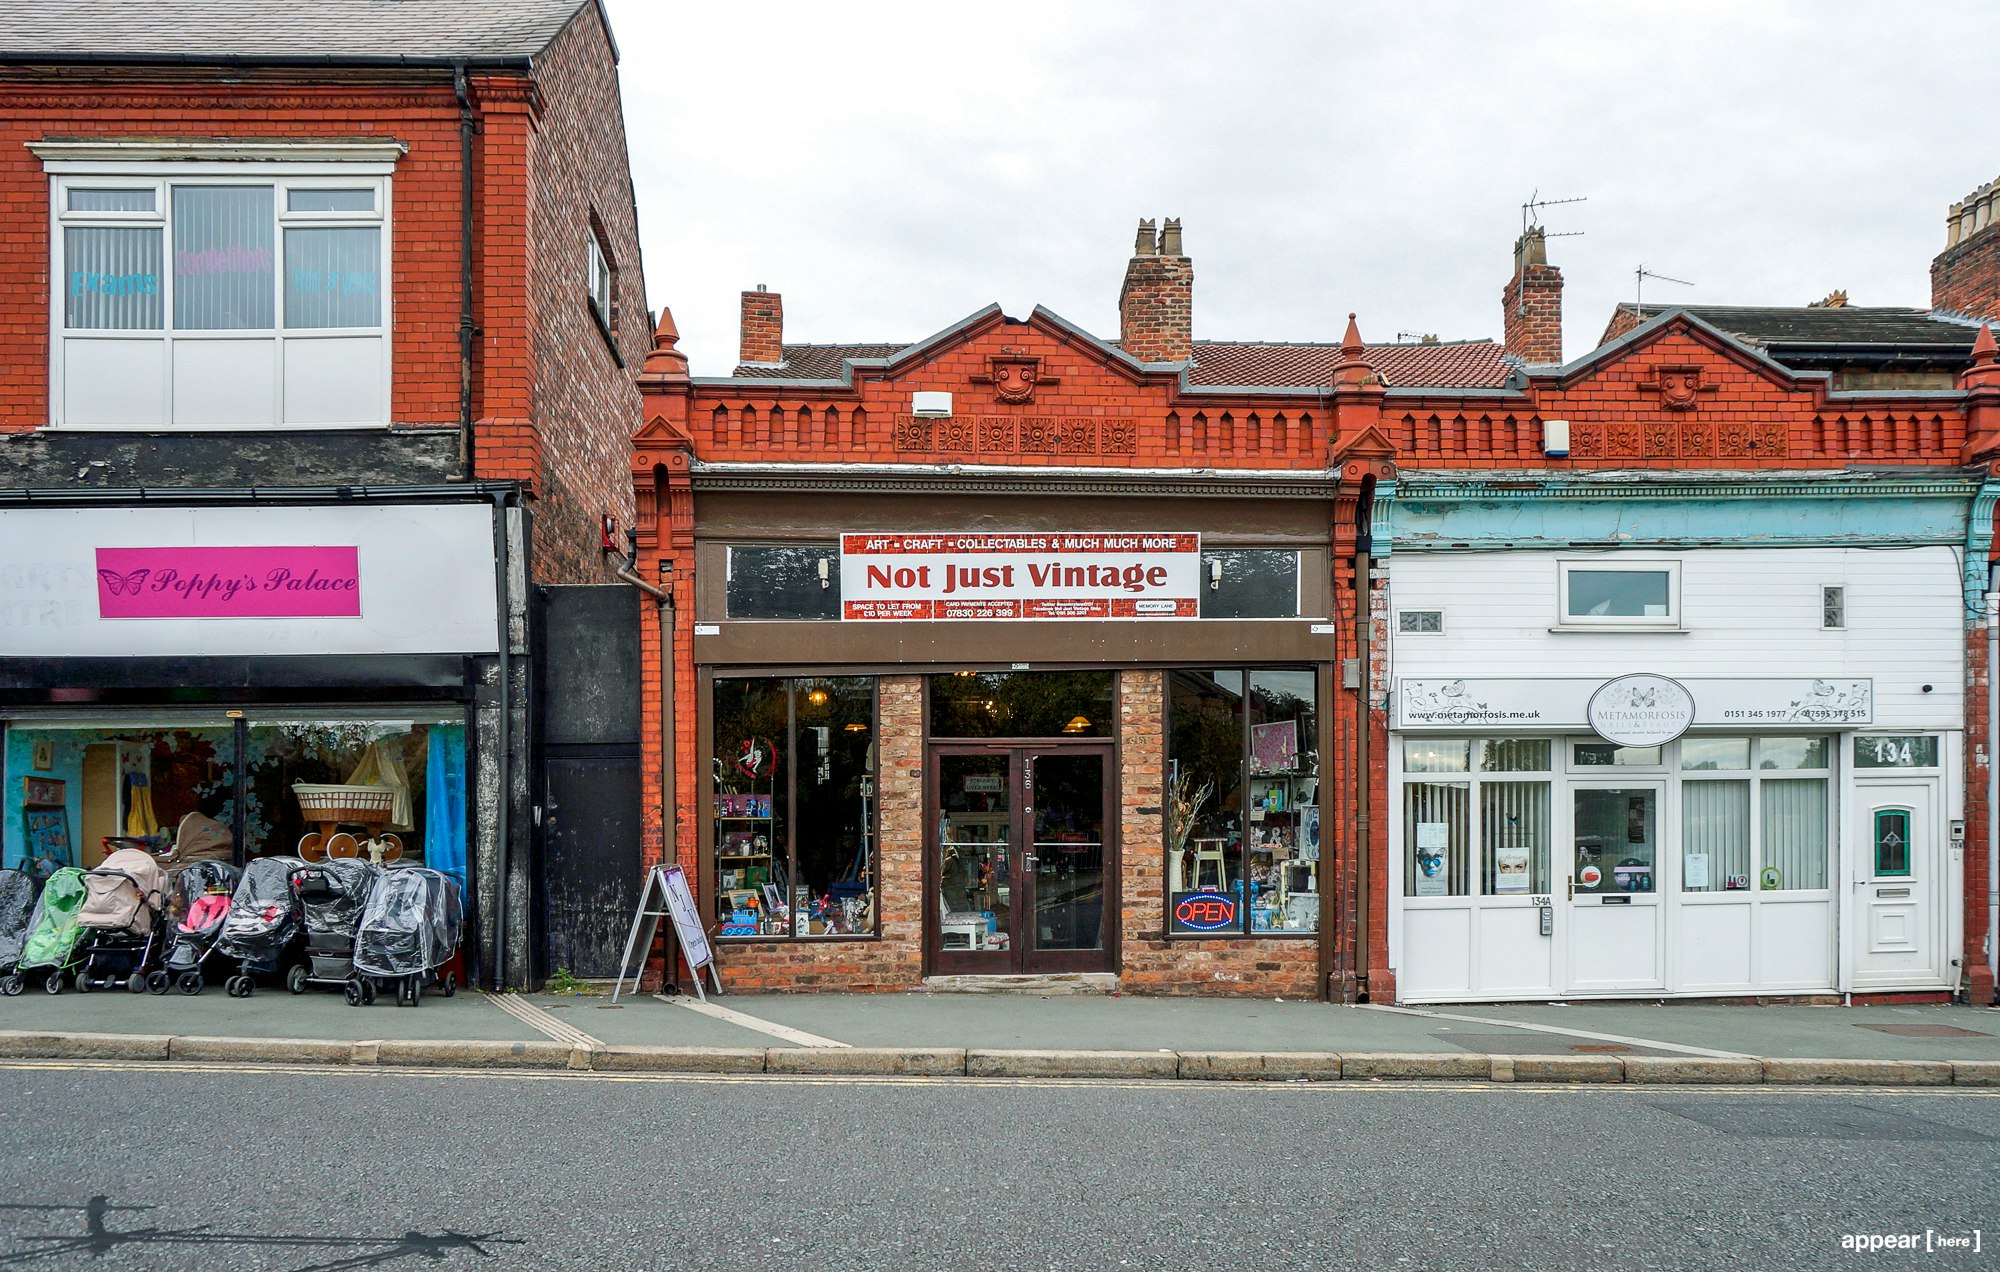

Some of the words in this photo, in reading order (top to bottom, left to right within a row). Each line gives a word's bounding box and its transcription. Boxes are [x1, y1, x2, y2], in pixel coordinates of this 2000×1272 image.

[73, 271, 158, 297] Exams
[866, 539, 890, 550] ART
[903, 539, 943, 550] CRAFT
[957, 538, 1047, 549] COLLECTABLES
[1052, 538, 1060, 549] &
[1064, 538, 1099, 549] MUCH
[1103, 538, 1138, 549] MUCH
[1142, 538, 1177, 549] MORE
[150, 568, 258, 601] Poppy's
[263, 567, 357, 591] Palace
[867, 564, 931, 589] Not
[942, 564, 1015, 594] Just
[1027, 562, 1168, 593] Vintage
[946, 609, 974, 617] 07830
[977, 609, 993, 617] 226
[996, 609, 1014, 617] 399
[1408, 710, 1540, 719] www.metamorfosis.me.uk
[1598, 711, 1686, 720] METAMORFOSIS
[1724, 710, 1745, 718] 0151
[1748, 710, 1764, 718] 345
[1766, 710, 1786, 718] 1977
[1851, 710, 1866, 718] 515
[1874, 742, 1911, 763] 134
[1531, 896, 1552, 906] 134A
[1176, 902, 1235, 922] OPEN
